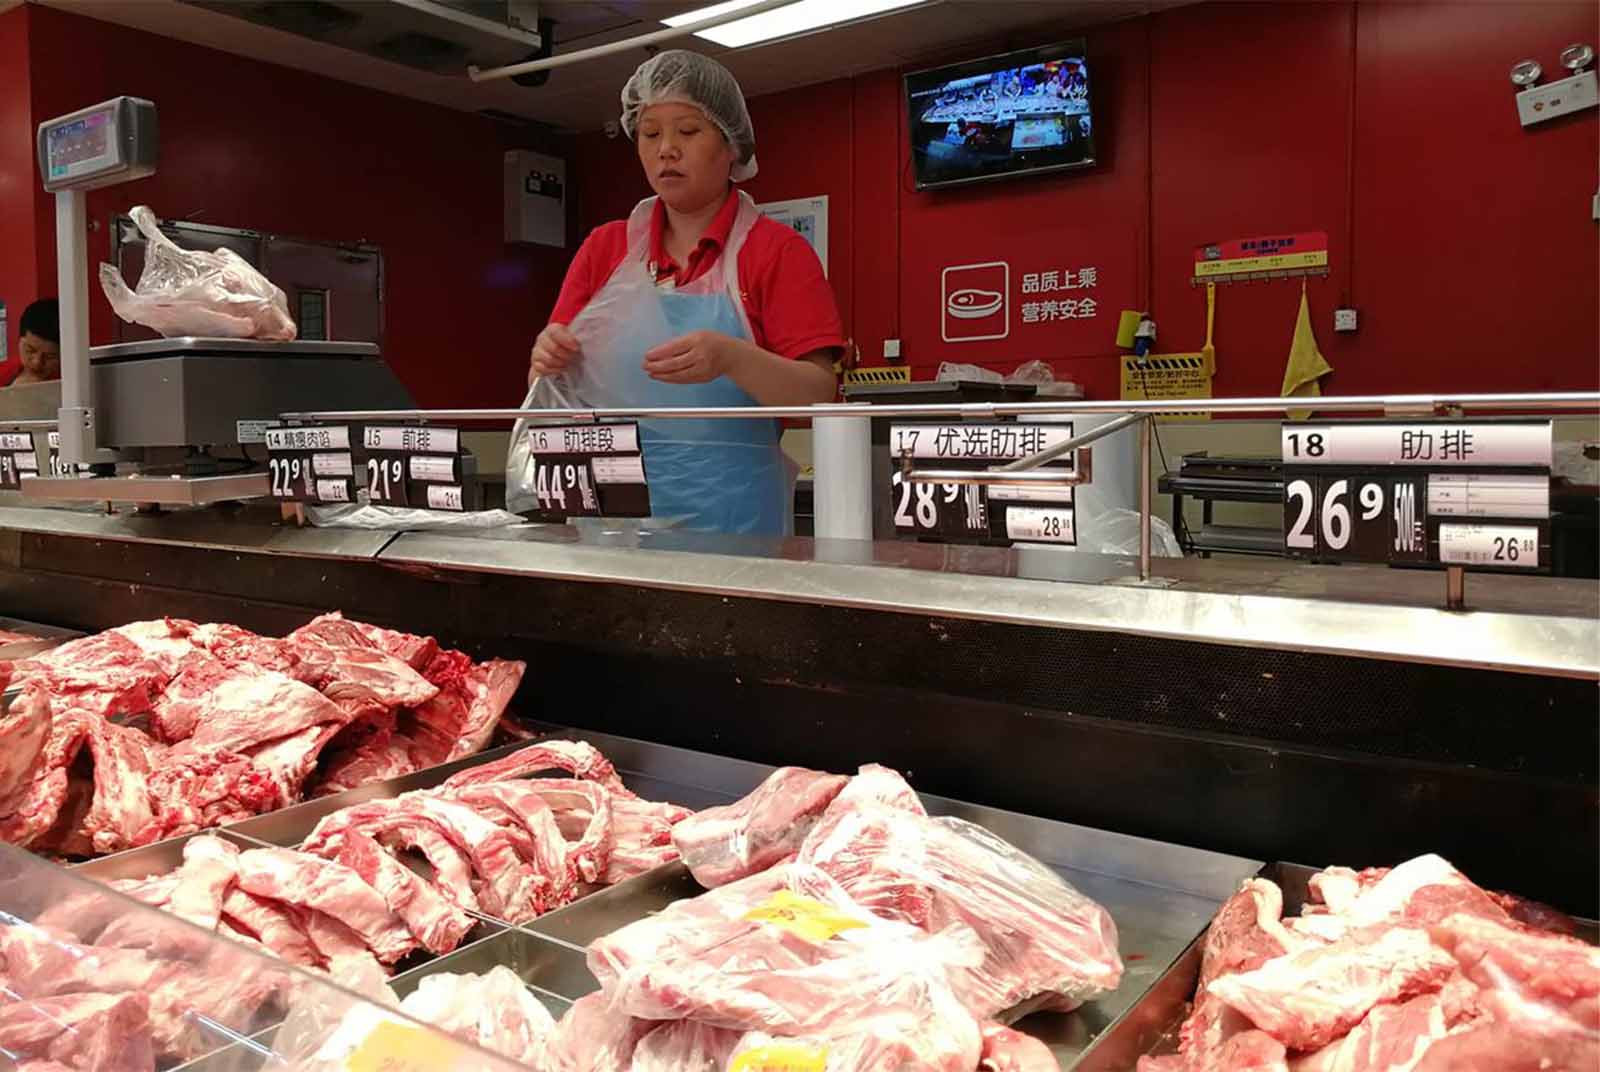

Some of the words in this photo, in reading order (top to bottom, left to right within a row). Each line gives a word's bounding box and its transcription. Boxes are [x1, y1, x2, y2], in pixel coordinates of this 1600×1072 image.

[1022, 267, 1097, 294] 品质上乘
[1022, 297, 1097, 323] 营养安全
[267, 432, 281, 447] 14
[284, 430, 330, 449] 精瘦肉馅
[367, 429, 382, 447] 15
[402, 427, 431, 450] 前排
[533, 431, 548, 450] 16
[564, 427, 615, 453] 肋排段
[898, 430, 920, 452] 17
[934, 427, 1047, 458] 优选肋排
[1288, 433, 1325, 457] 18
[1400, 429, 1474, 460] 肋排
